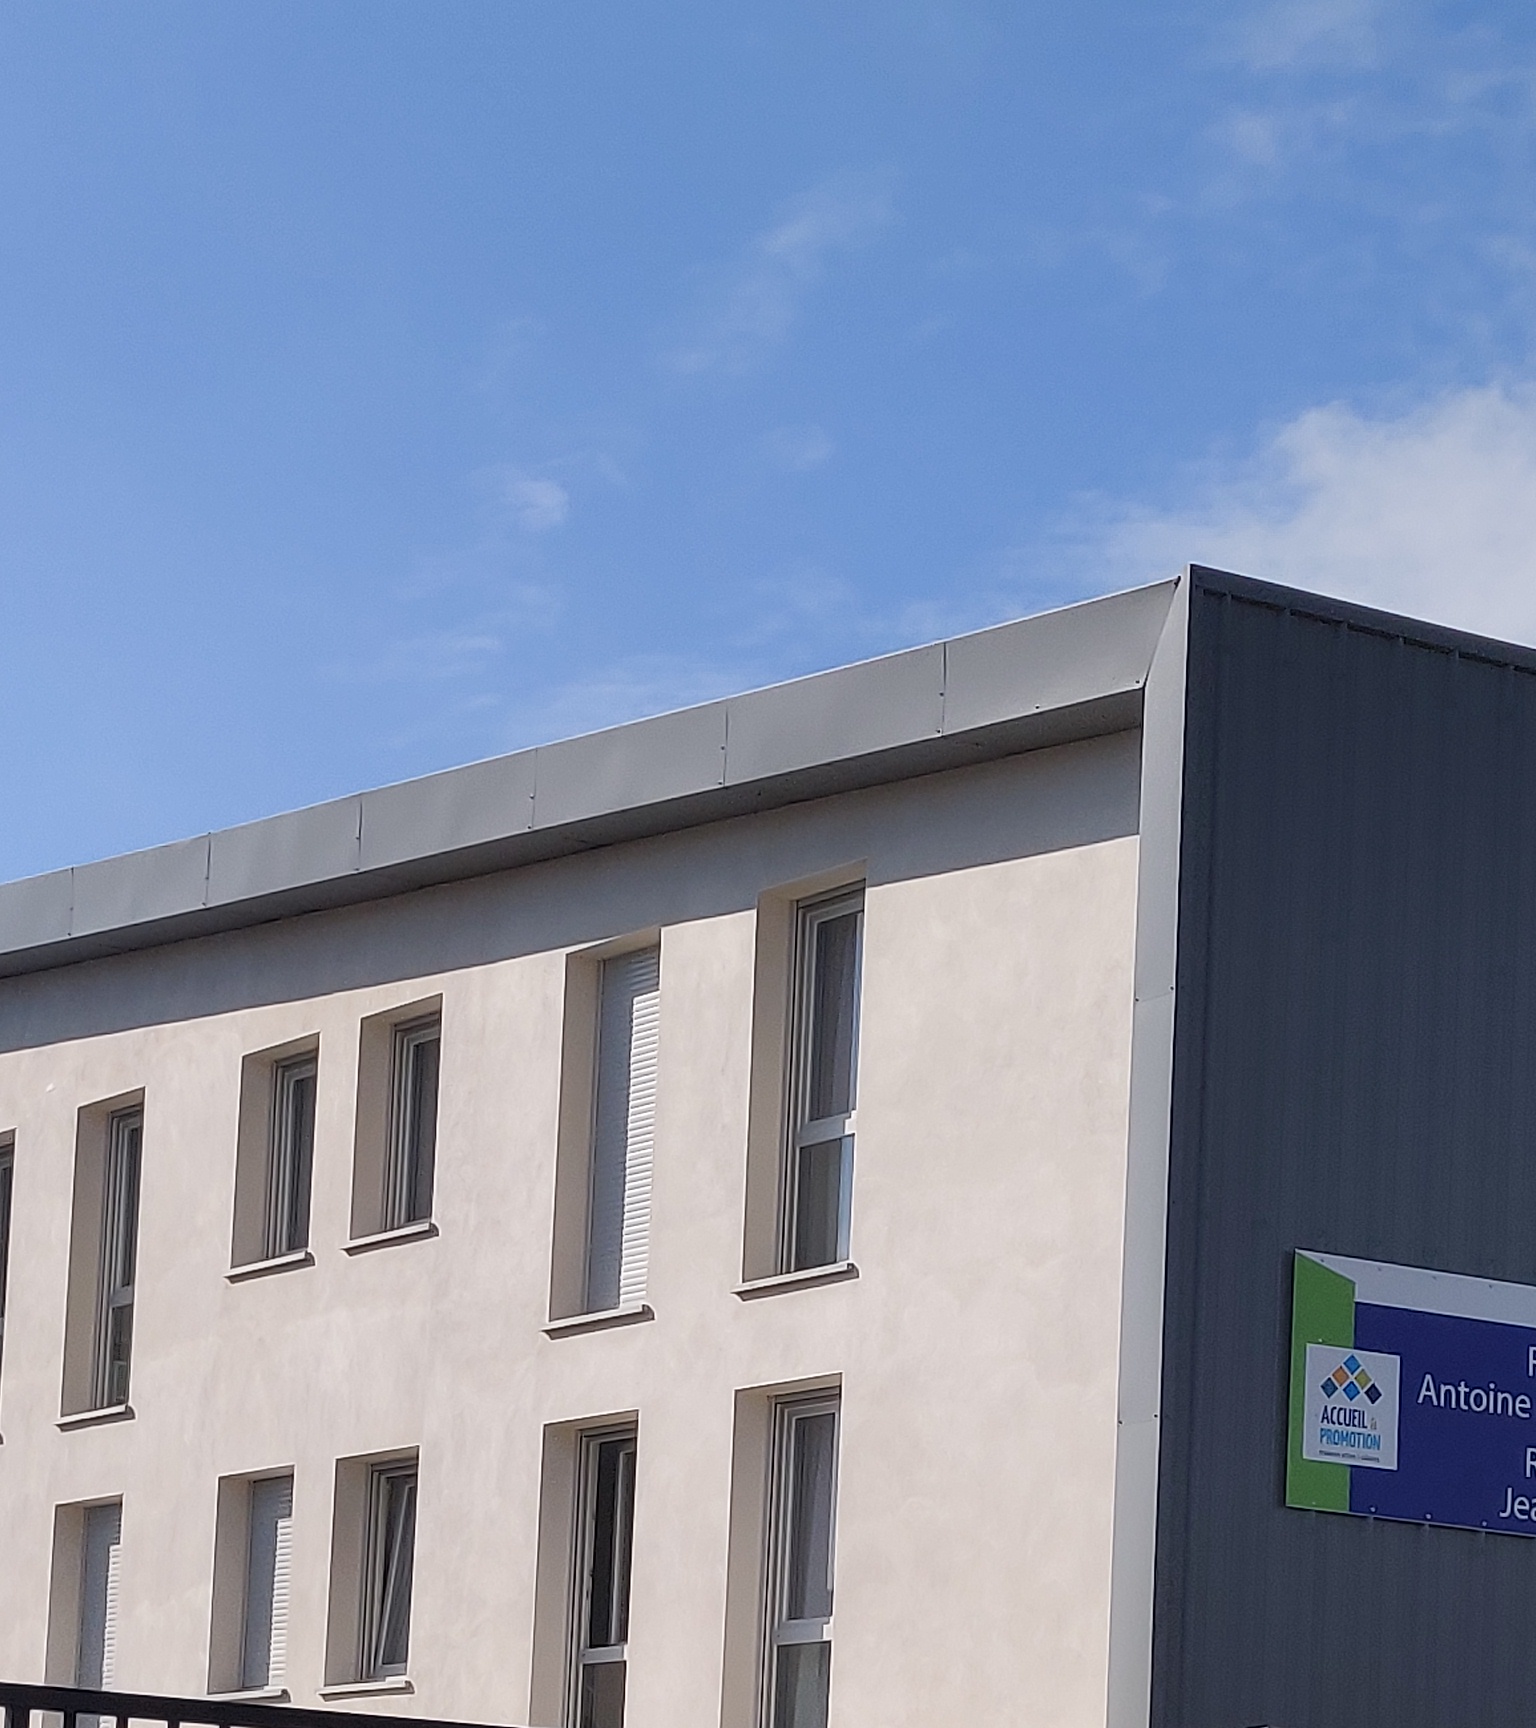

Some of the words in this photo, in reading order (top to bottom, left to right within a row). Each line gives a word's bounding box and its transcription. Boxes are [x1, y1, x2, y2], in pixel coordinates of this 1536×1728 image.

[1417, 1373, 1531, 1418] Antoine
[1320, 1405, 1368, 1429] ACCUEIL
[1319, 1428, 1381, 1451] PROMOTION
